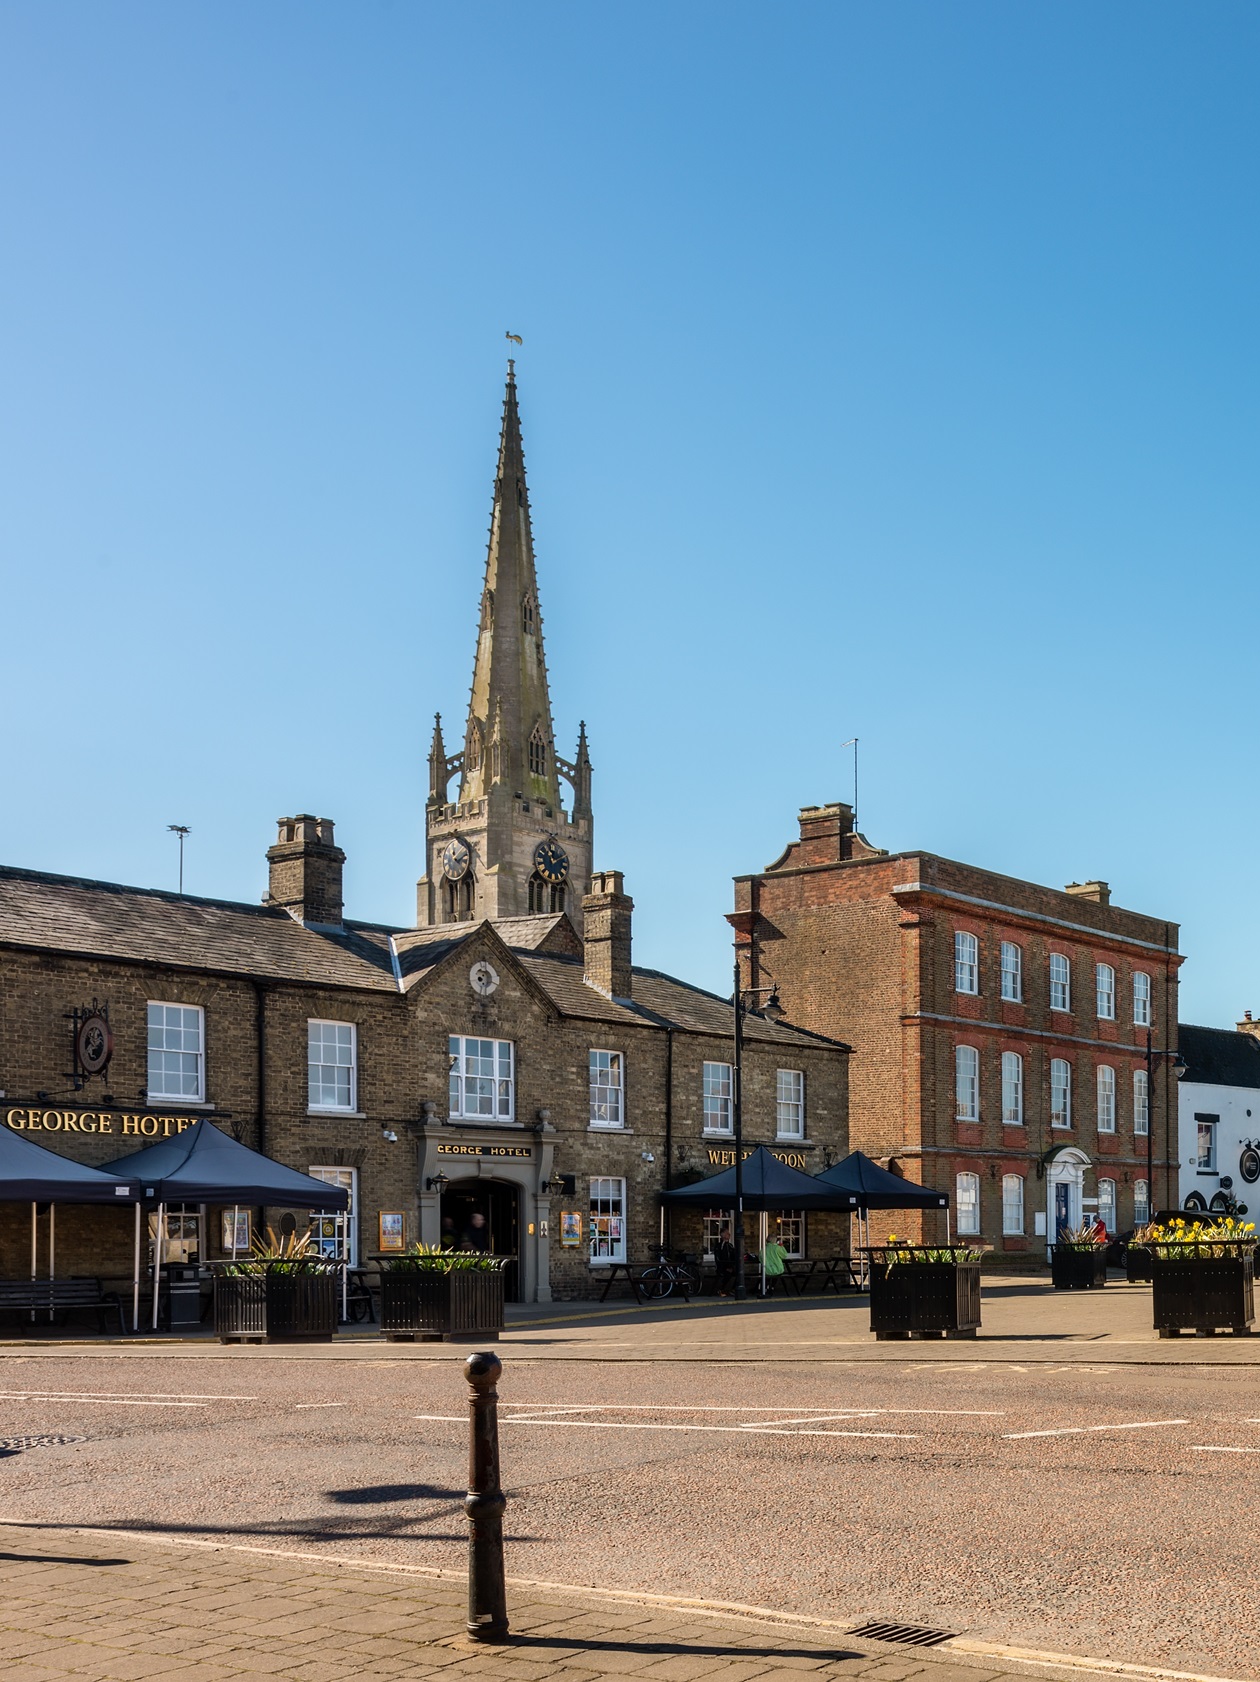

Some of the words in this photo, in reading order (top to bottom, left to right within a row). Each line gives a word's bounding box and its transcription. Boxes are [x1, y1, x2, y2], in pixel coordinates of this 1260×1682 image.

[7, 1109, 112, 1133] GEORGE
[121, 1115, 198, 1136] HOTE
[437, 1145, 482, 1155] GEORGE
[490, 1147, 530, 1156] HOTEL
[707, 1150, 806, 1168] WETOON
